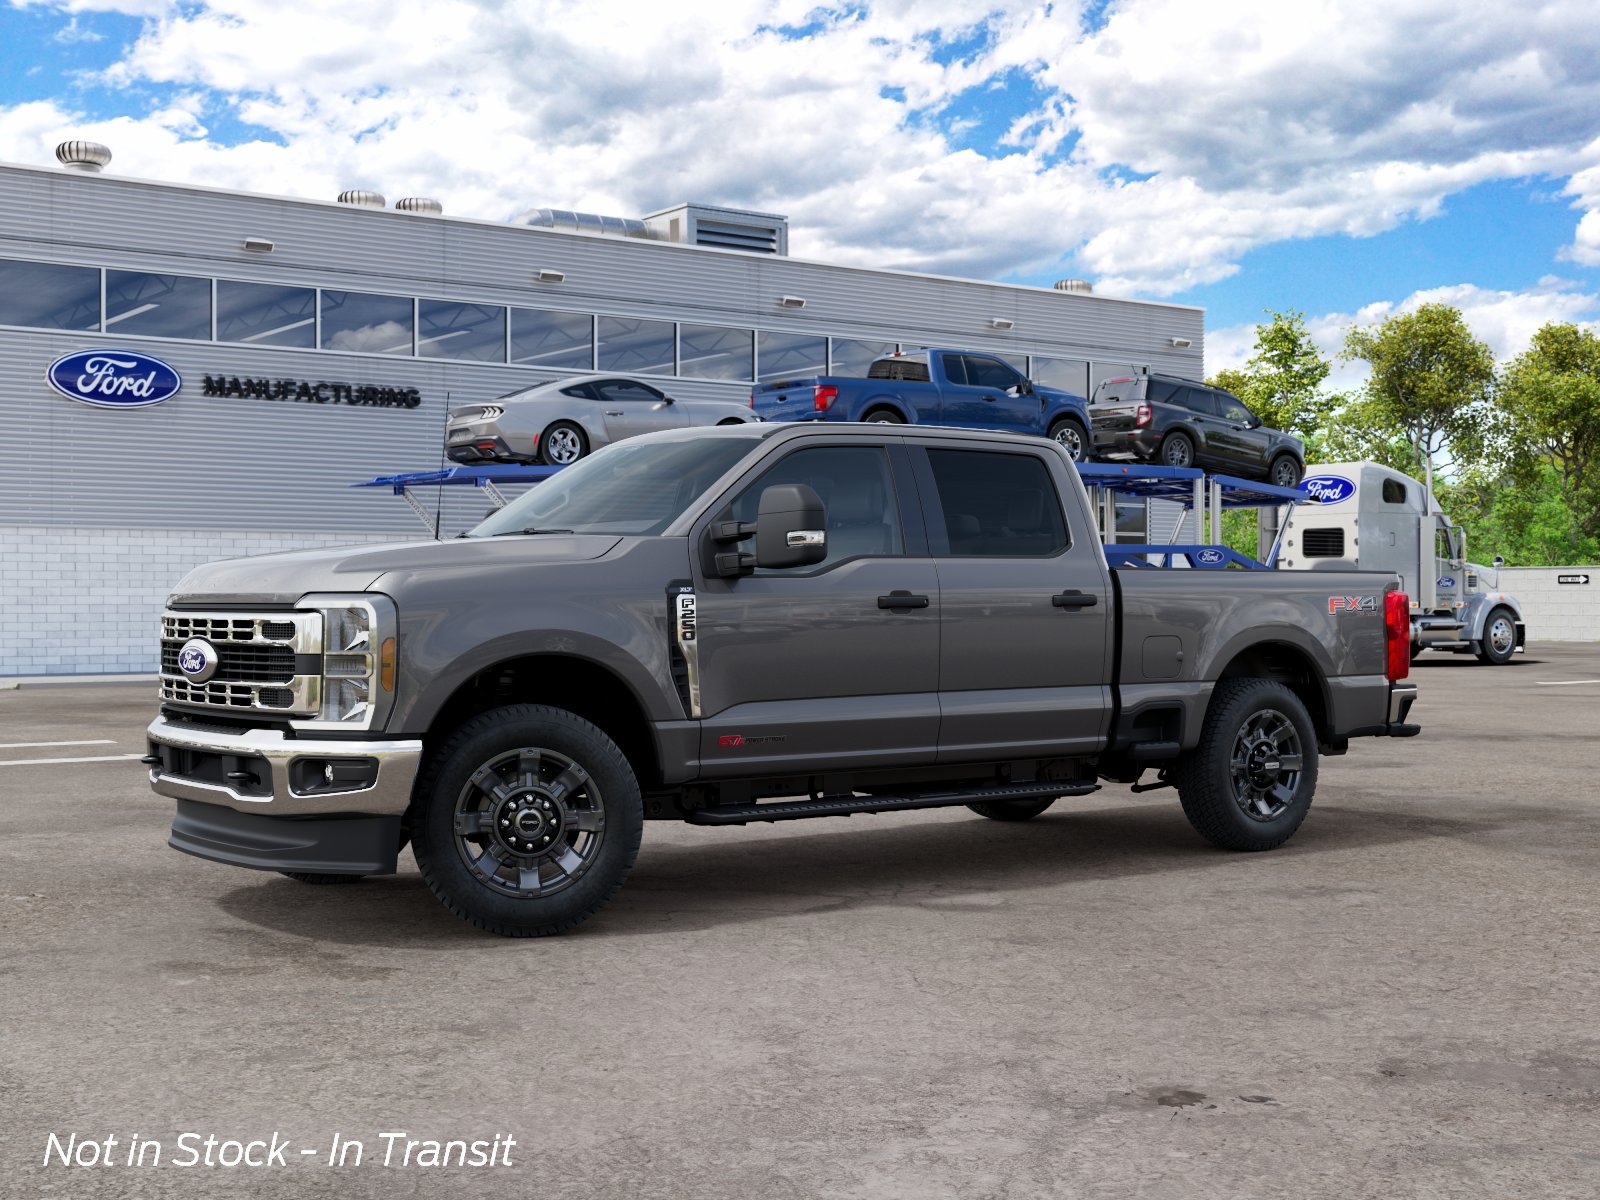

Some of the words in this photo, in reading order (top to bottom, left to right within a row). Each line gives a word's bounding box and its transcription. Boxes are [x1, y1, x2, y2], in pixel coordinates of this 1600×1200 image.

[76, 356, 157, 398] Ford
[203, 373, 422, 409] MANUFACTURING
[1307, 479, 1344, 500] Ford
[1328, 595, 1378, 616] FX4
